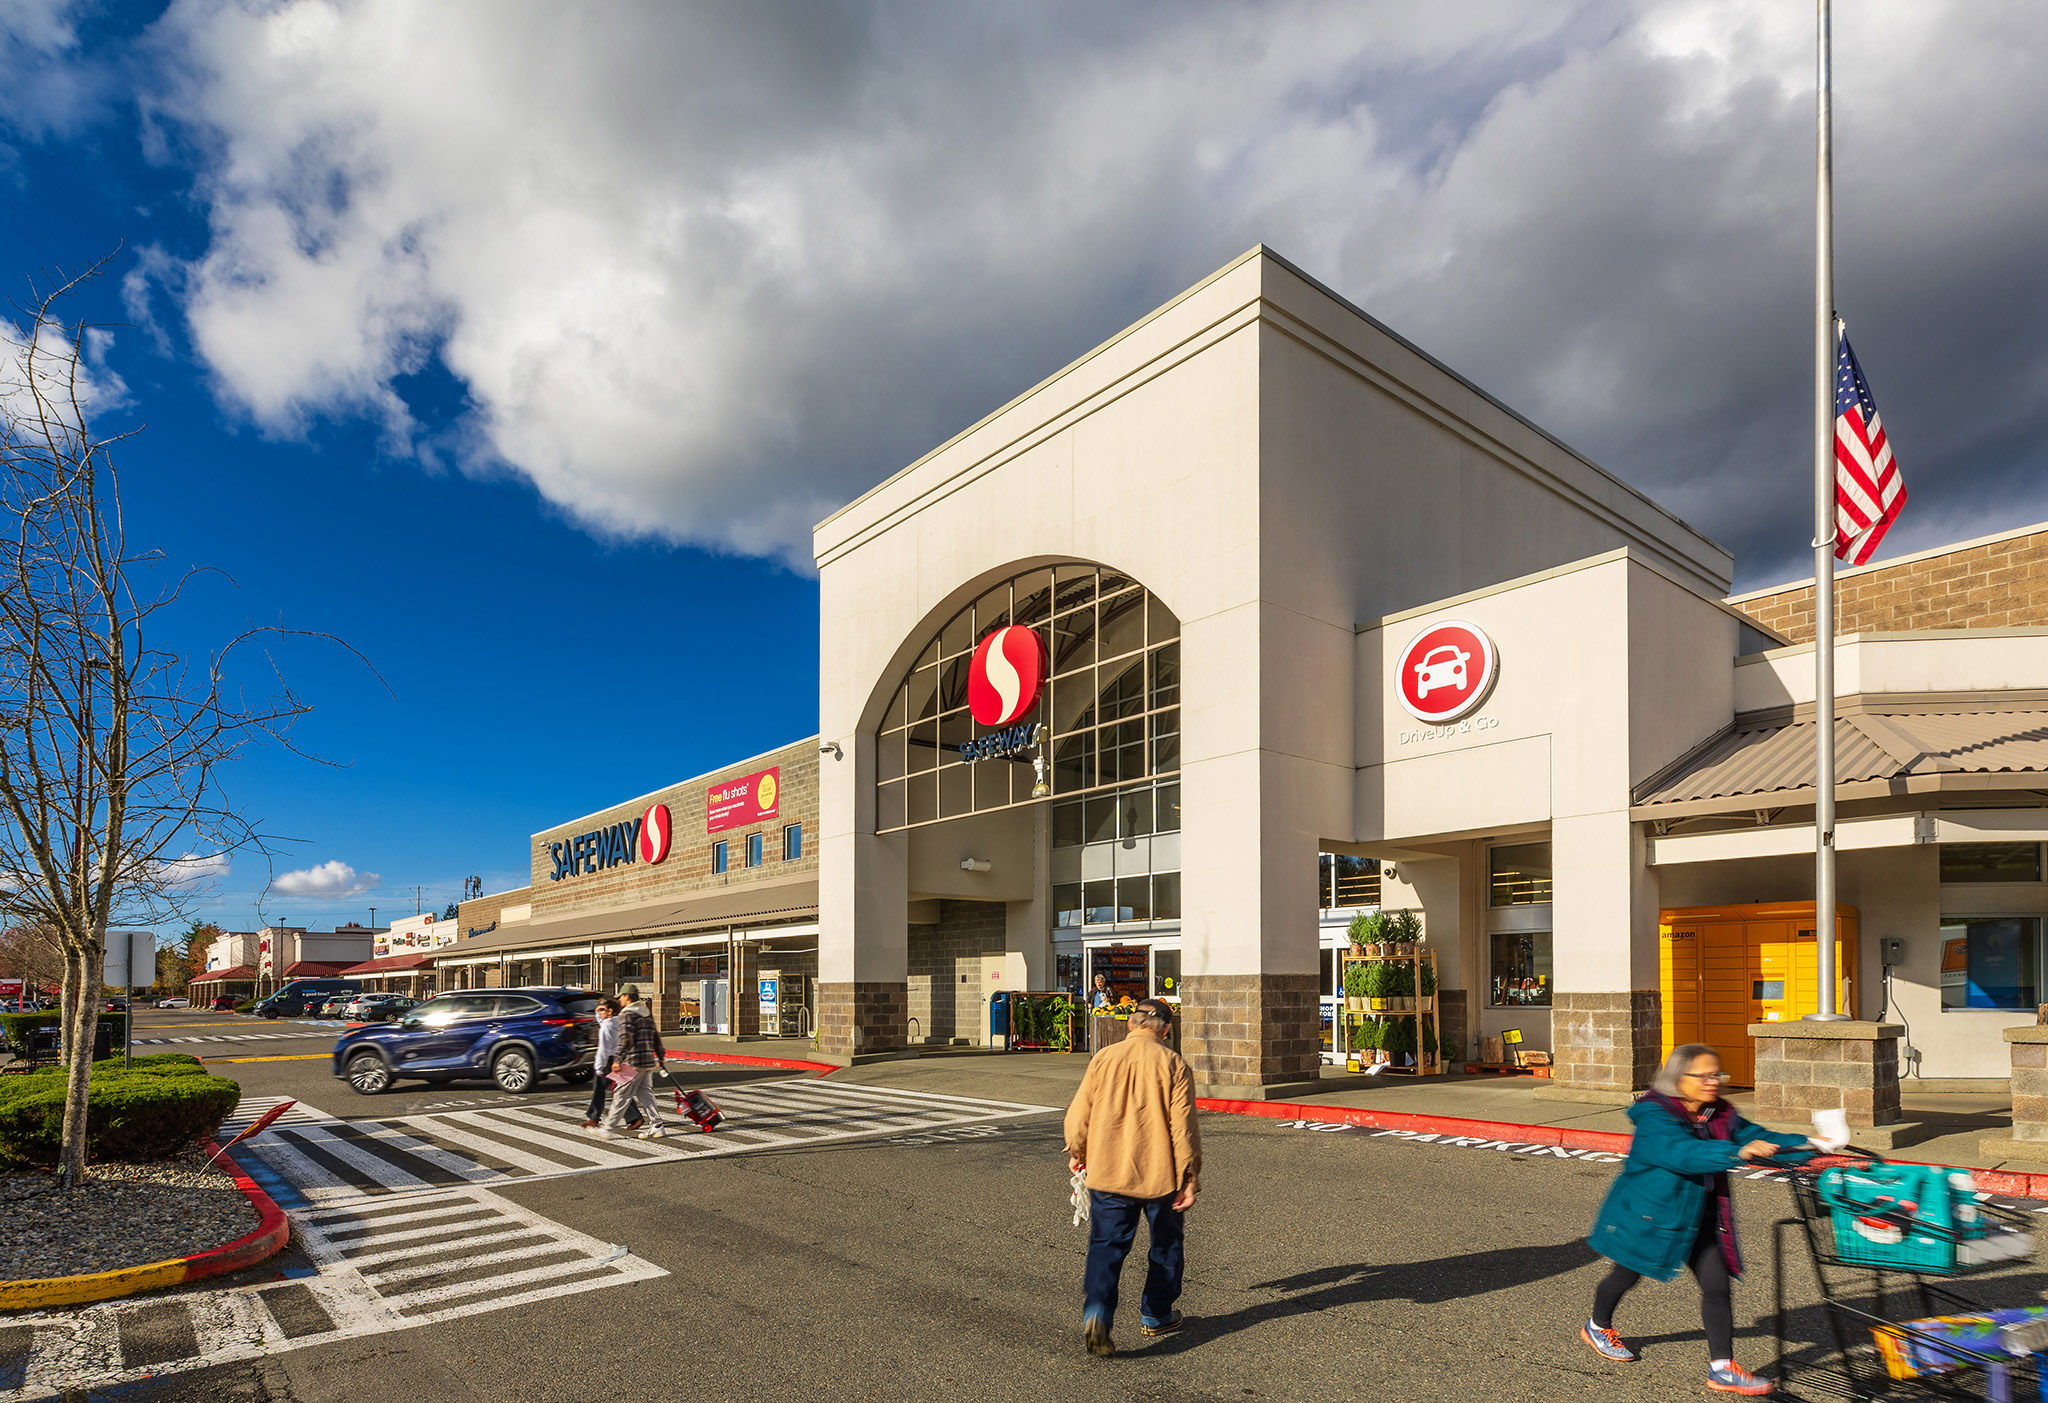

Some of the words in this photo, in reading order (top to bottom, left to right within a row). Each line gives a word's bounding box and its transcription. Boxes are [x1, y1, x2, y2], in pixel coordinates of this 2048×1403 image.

[959, 722, 1033, 761] SAFEWAY
[1400, 724, 1456, 745] DriveUp
[1459, 719, 1472, 733] &
[1476, 716, 1499, 730] Go
[709, 793, 722, 805] Free
[722, 789, 731, 801] flu
[550, 818, 642, 881] SAFEWAY
[1661, 931, 1696, 940] amazon
[1276, 1120, 1353, 1132] NO
[1370, 1129, 1629, 1162] PARKING
